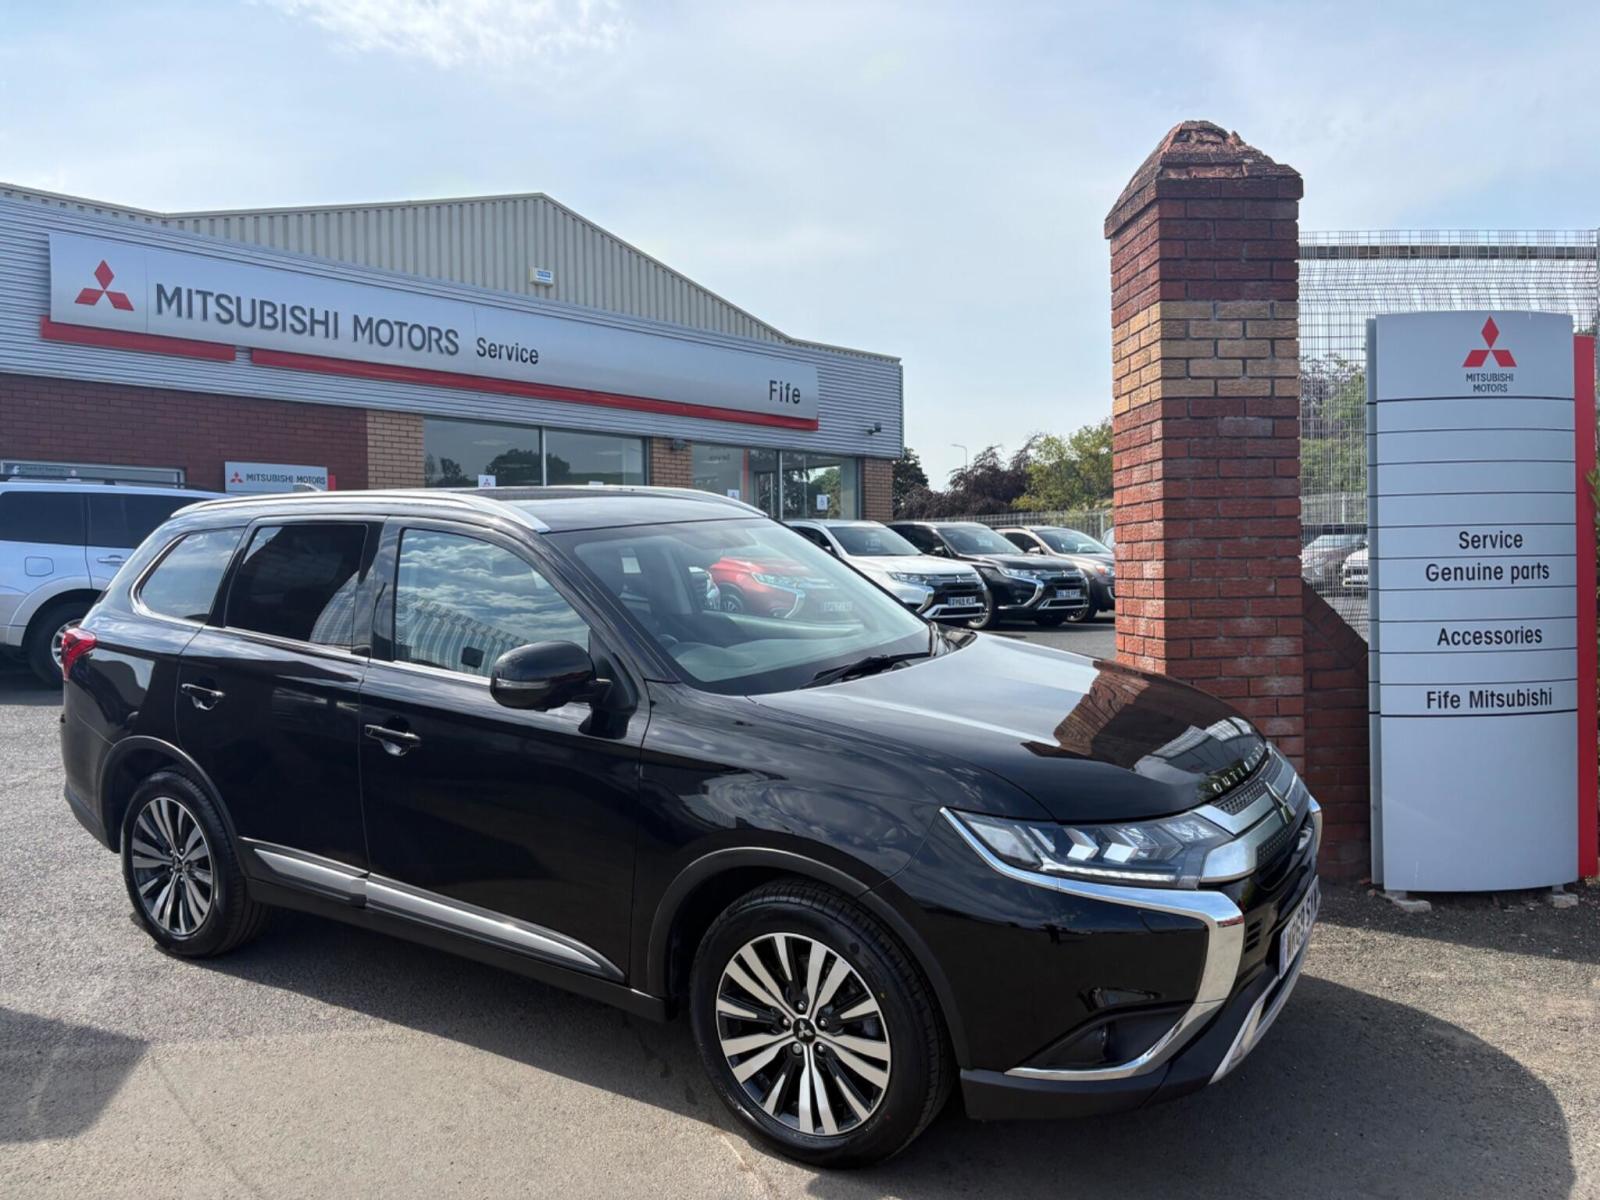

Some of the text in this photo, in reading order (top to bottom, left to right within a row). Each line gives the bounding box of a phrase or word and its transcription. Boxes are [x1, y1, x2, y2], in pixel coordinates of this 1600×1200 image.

[156, 283, 539, 365] MITSUBISHI MOTORS Service
[1466, 372, 1514, 383] MITSUBISHI
[1473, 383, 1508, 393] MOTORS
[769, 380, 801, 404] Fife
[246, 473, 326, 486] MITSUBISHI MOTORS
[1458, 530, 1523, 550] Service
[1425, 562, 1550, 584] Genuine parts
[1437, 625, 1543, 646] Accessories
[1426, 687, 1553, 709] Fife Mitsubishi
